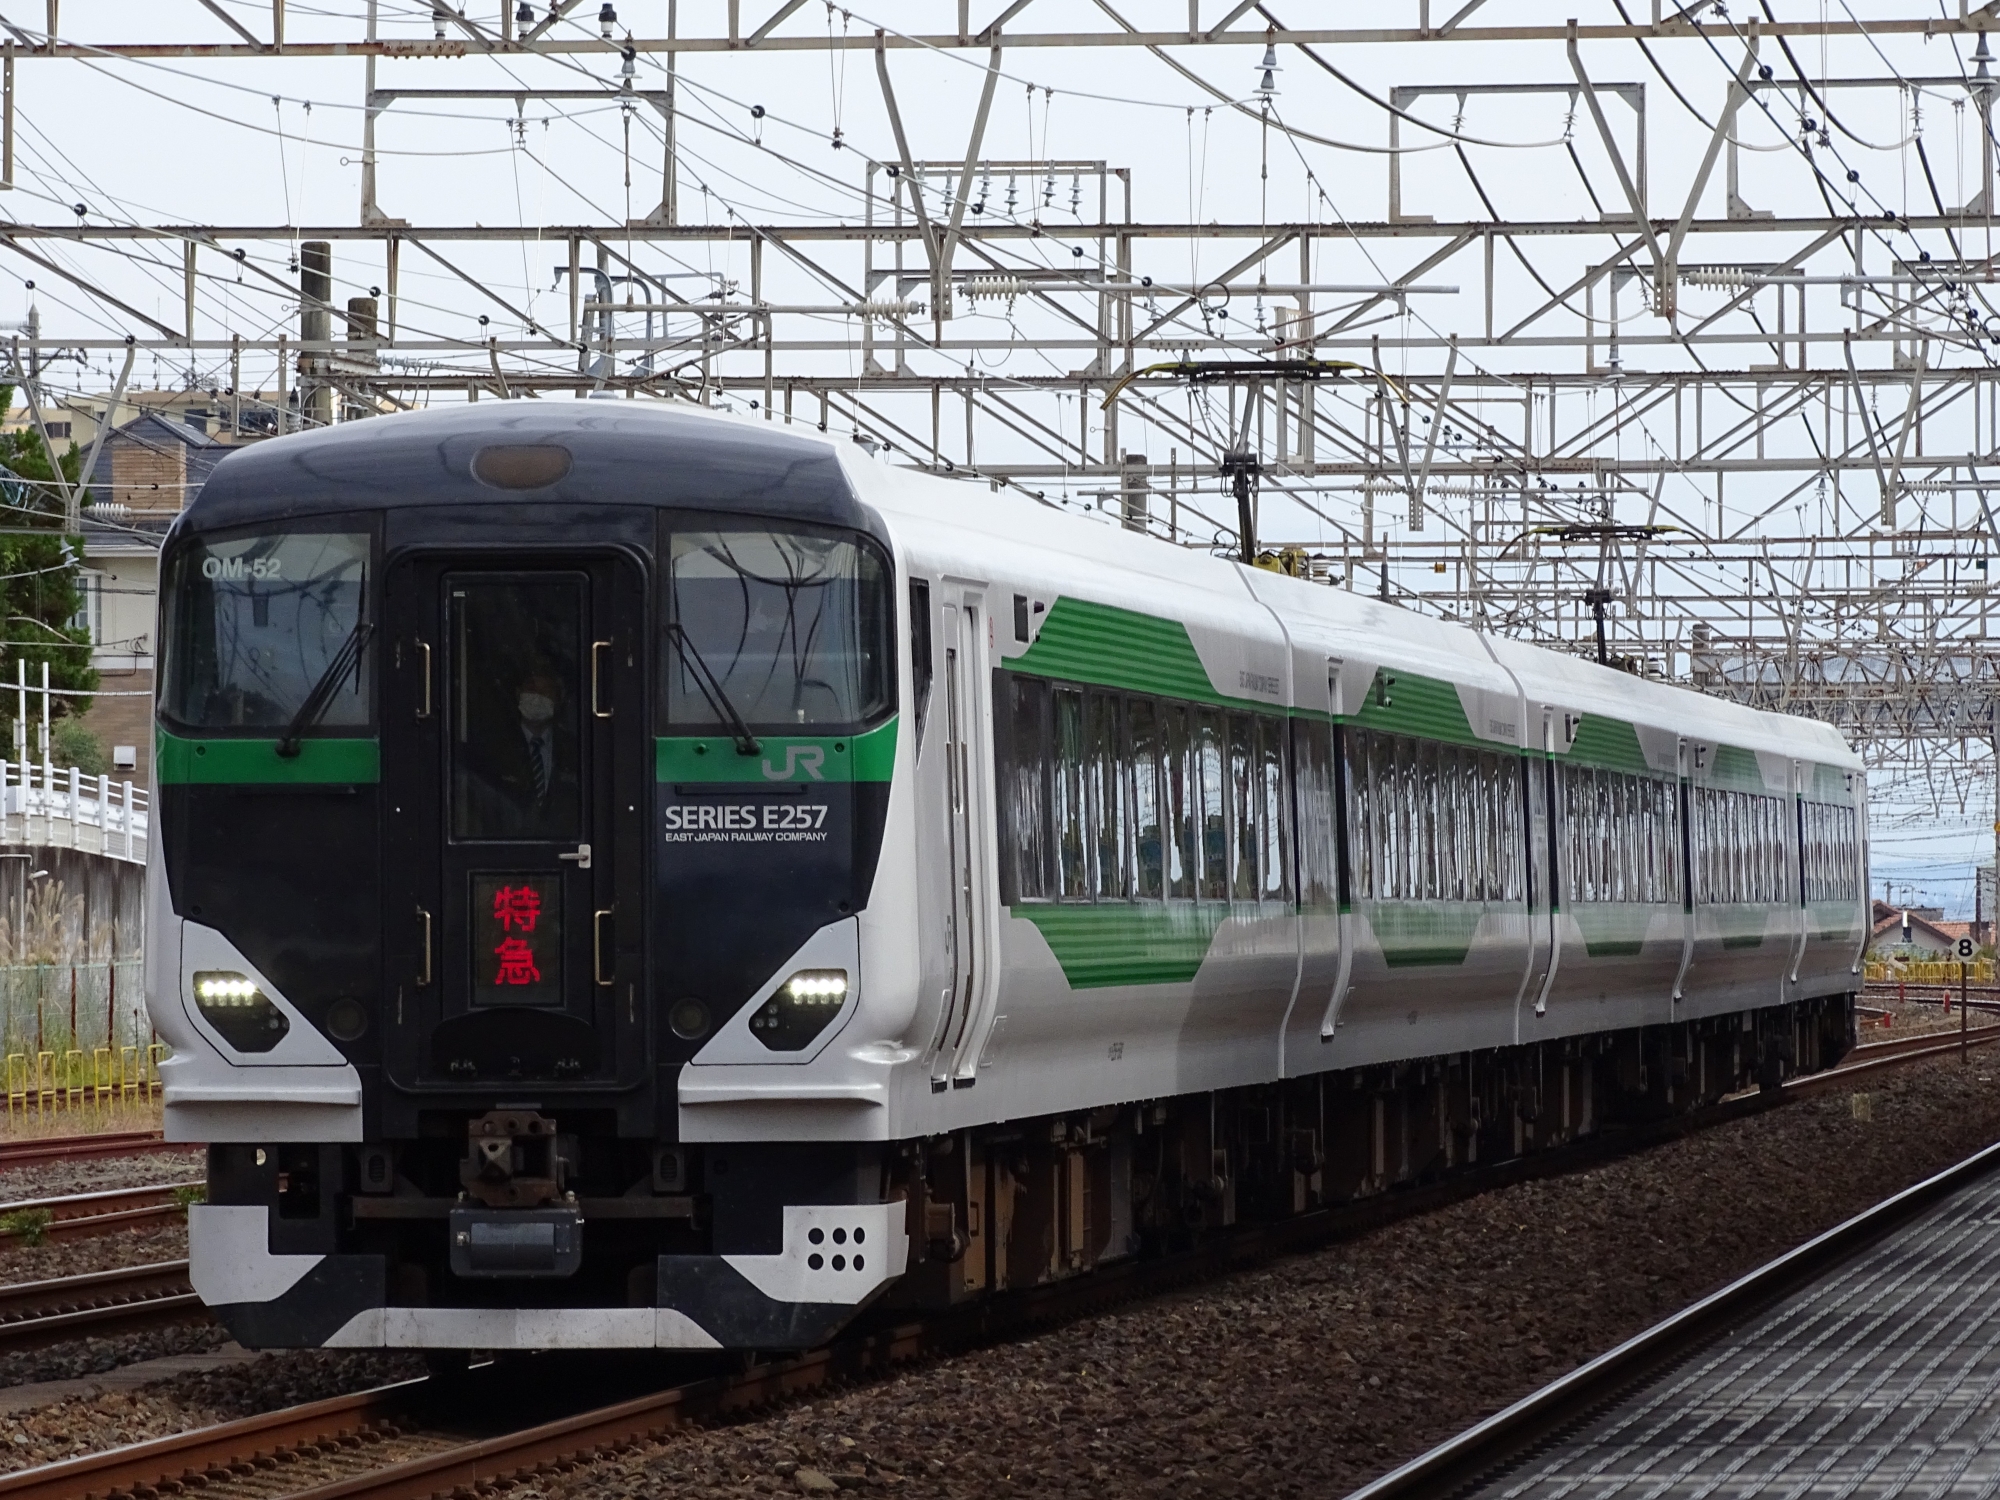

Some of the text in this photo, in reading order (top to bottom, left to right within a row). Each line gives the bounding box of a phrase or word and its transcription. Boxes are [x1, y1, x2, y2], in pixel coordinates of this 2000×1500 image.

[202, 557, 281, 579] OM-52
[762, 745, 825, 780] JR
[665, 804, 828, 830] SERIES E257
[665, 832, 828, 842] EAST JAPAN RAILWAY COMPANY
[493, 885, 541, 985] 特急
[1958, 938, 1973, 957] 8
